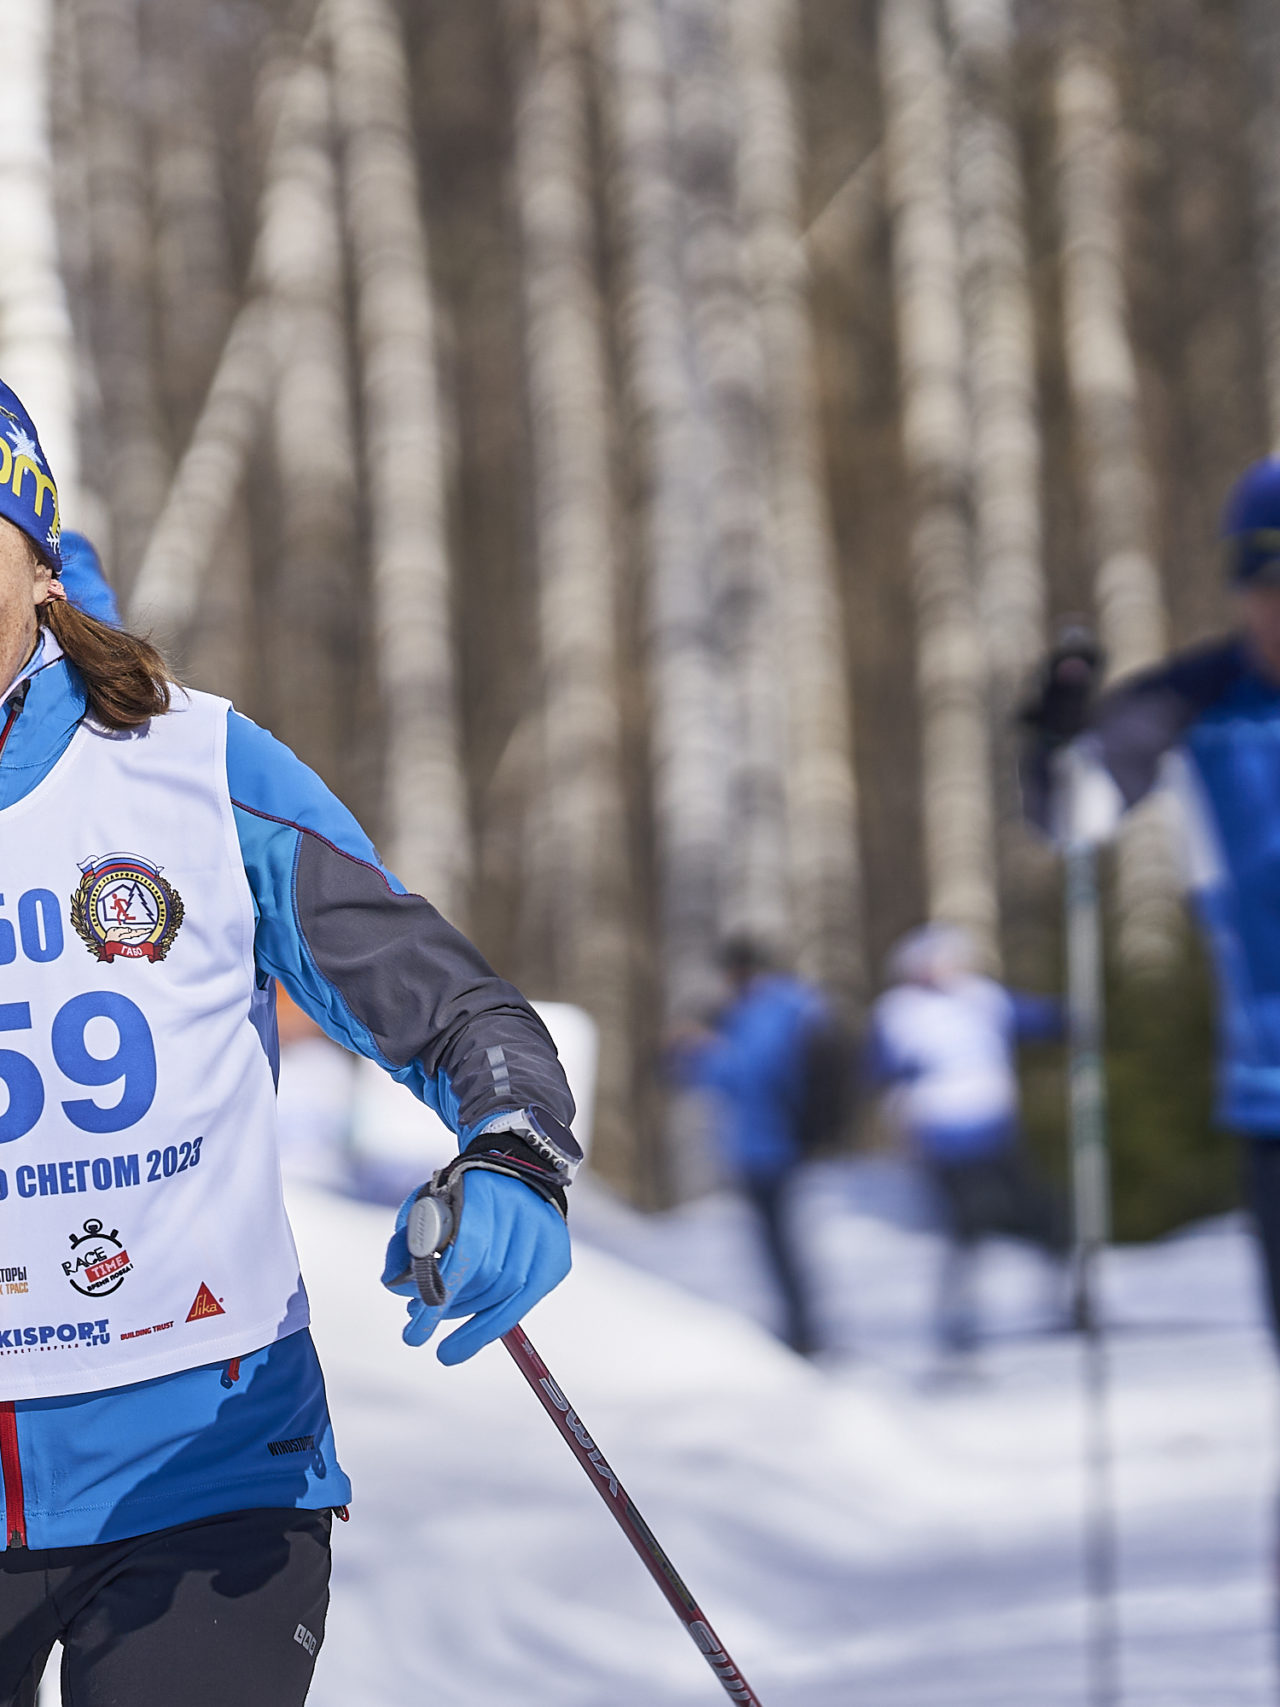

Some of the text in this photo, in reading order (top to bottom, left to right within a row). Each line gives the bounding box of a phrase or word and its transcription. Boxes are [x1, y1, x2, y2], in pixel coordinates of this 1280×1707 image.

[121, 945, 143, 956] ГАБО
[15, 1153, 140, 1199] СНЕГОМ
[146, 1136, 204, 1182] 2023
[61, 1246, 108, 1276] RACE
[91, 1256, 124, 1278] TIME
[5, 1282, 29, 1295] ТРАСС
[190, 1293, 218, 1318] Sika
[120, 1320, 175, 1341] BUILDING TRUST
[267, 1435, 315, 1457] WINDSTO
